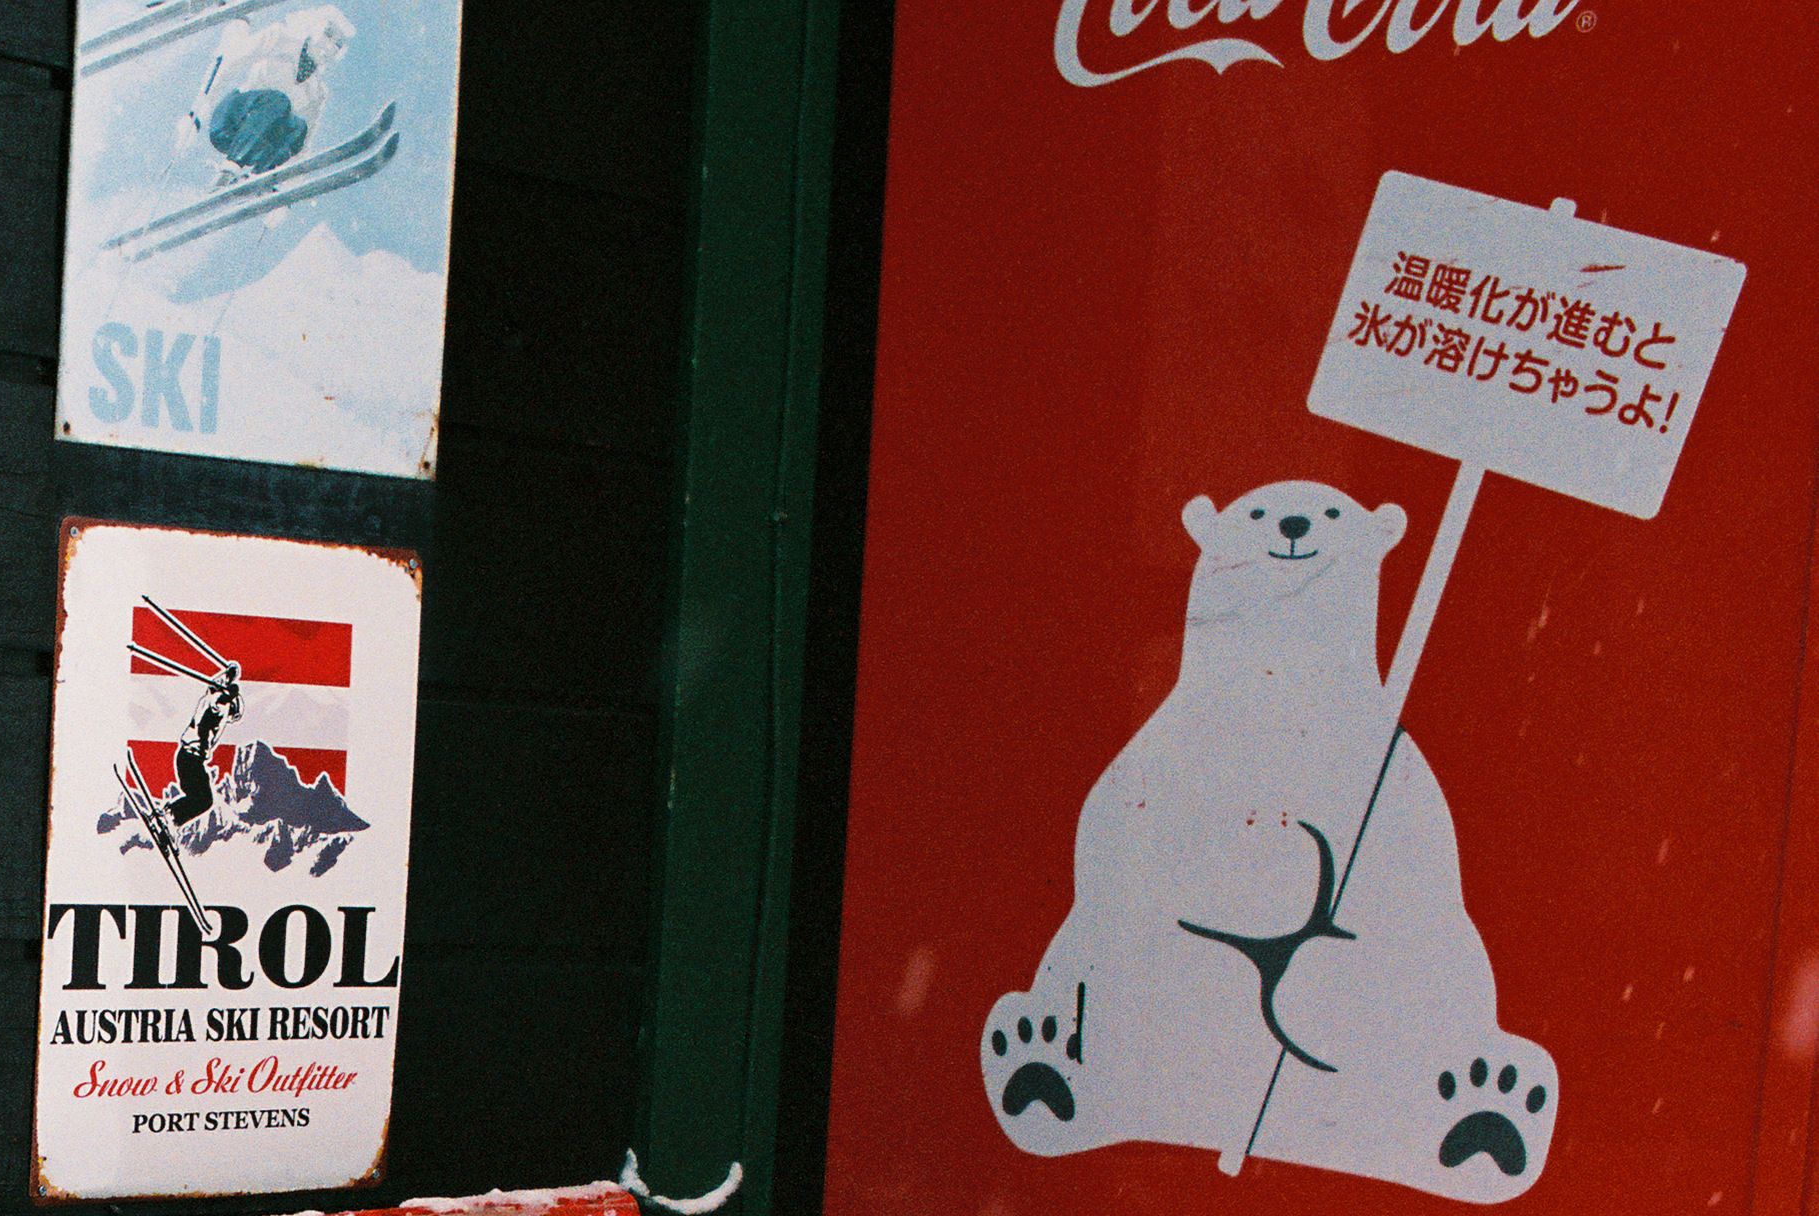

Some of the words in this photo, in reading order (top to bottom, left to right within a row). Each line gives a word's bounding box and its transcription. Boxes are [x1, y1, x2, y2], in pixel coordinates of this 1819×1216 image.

[1384, 251, 1676, 370] 温暖化が進むと
[88, 321, 222, 434] SKI
[48, 903, 401, 991] TIROL
[50, 1008, 195, 1045] AUSTRIA
[205, 1007, 260, 1042] SKI
[268, 1005, 391, 1040] RESORT
[72, 1057, 158, 1098] Snow
[165, 1066, 185, 1096] &
[190, 1057, 242, 1096] Ski
[247, 1055, 358, 1094] Outfitter
[132, 1112, 200, 1134] PORT
[204, 1108, 310, 1131] STEVENS
